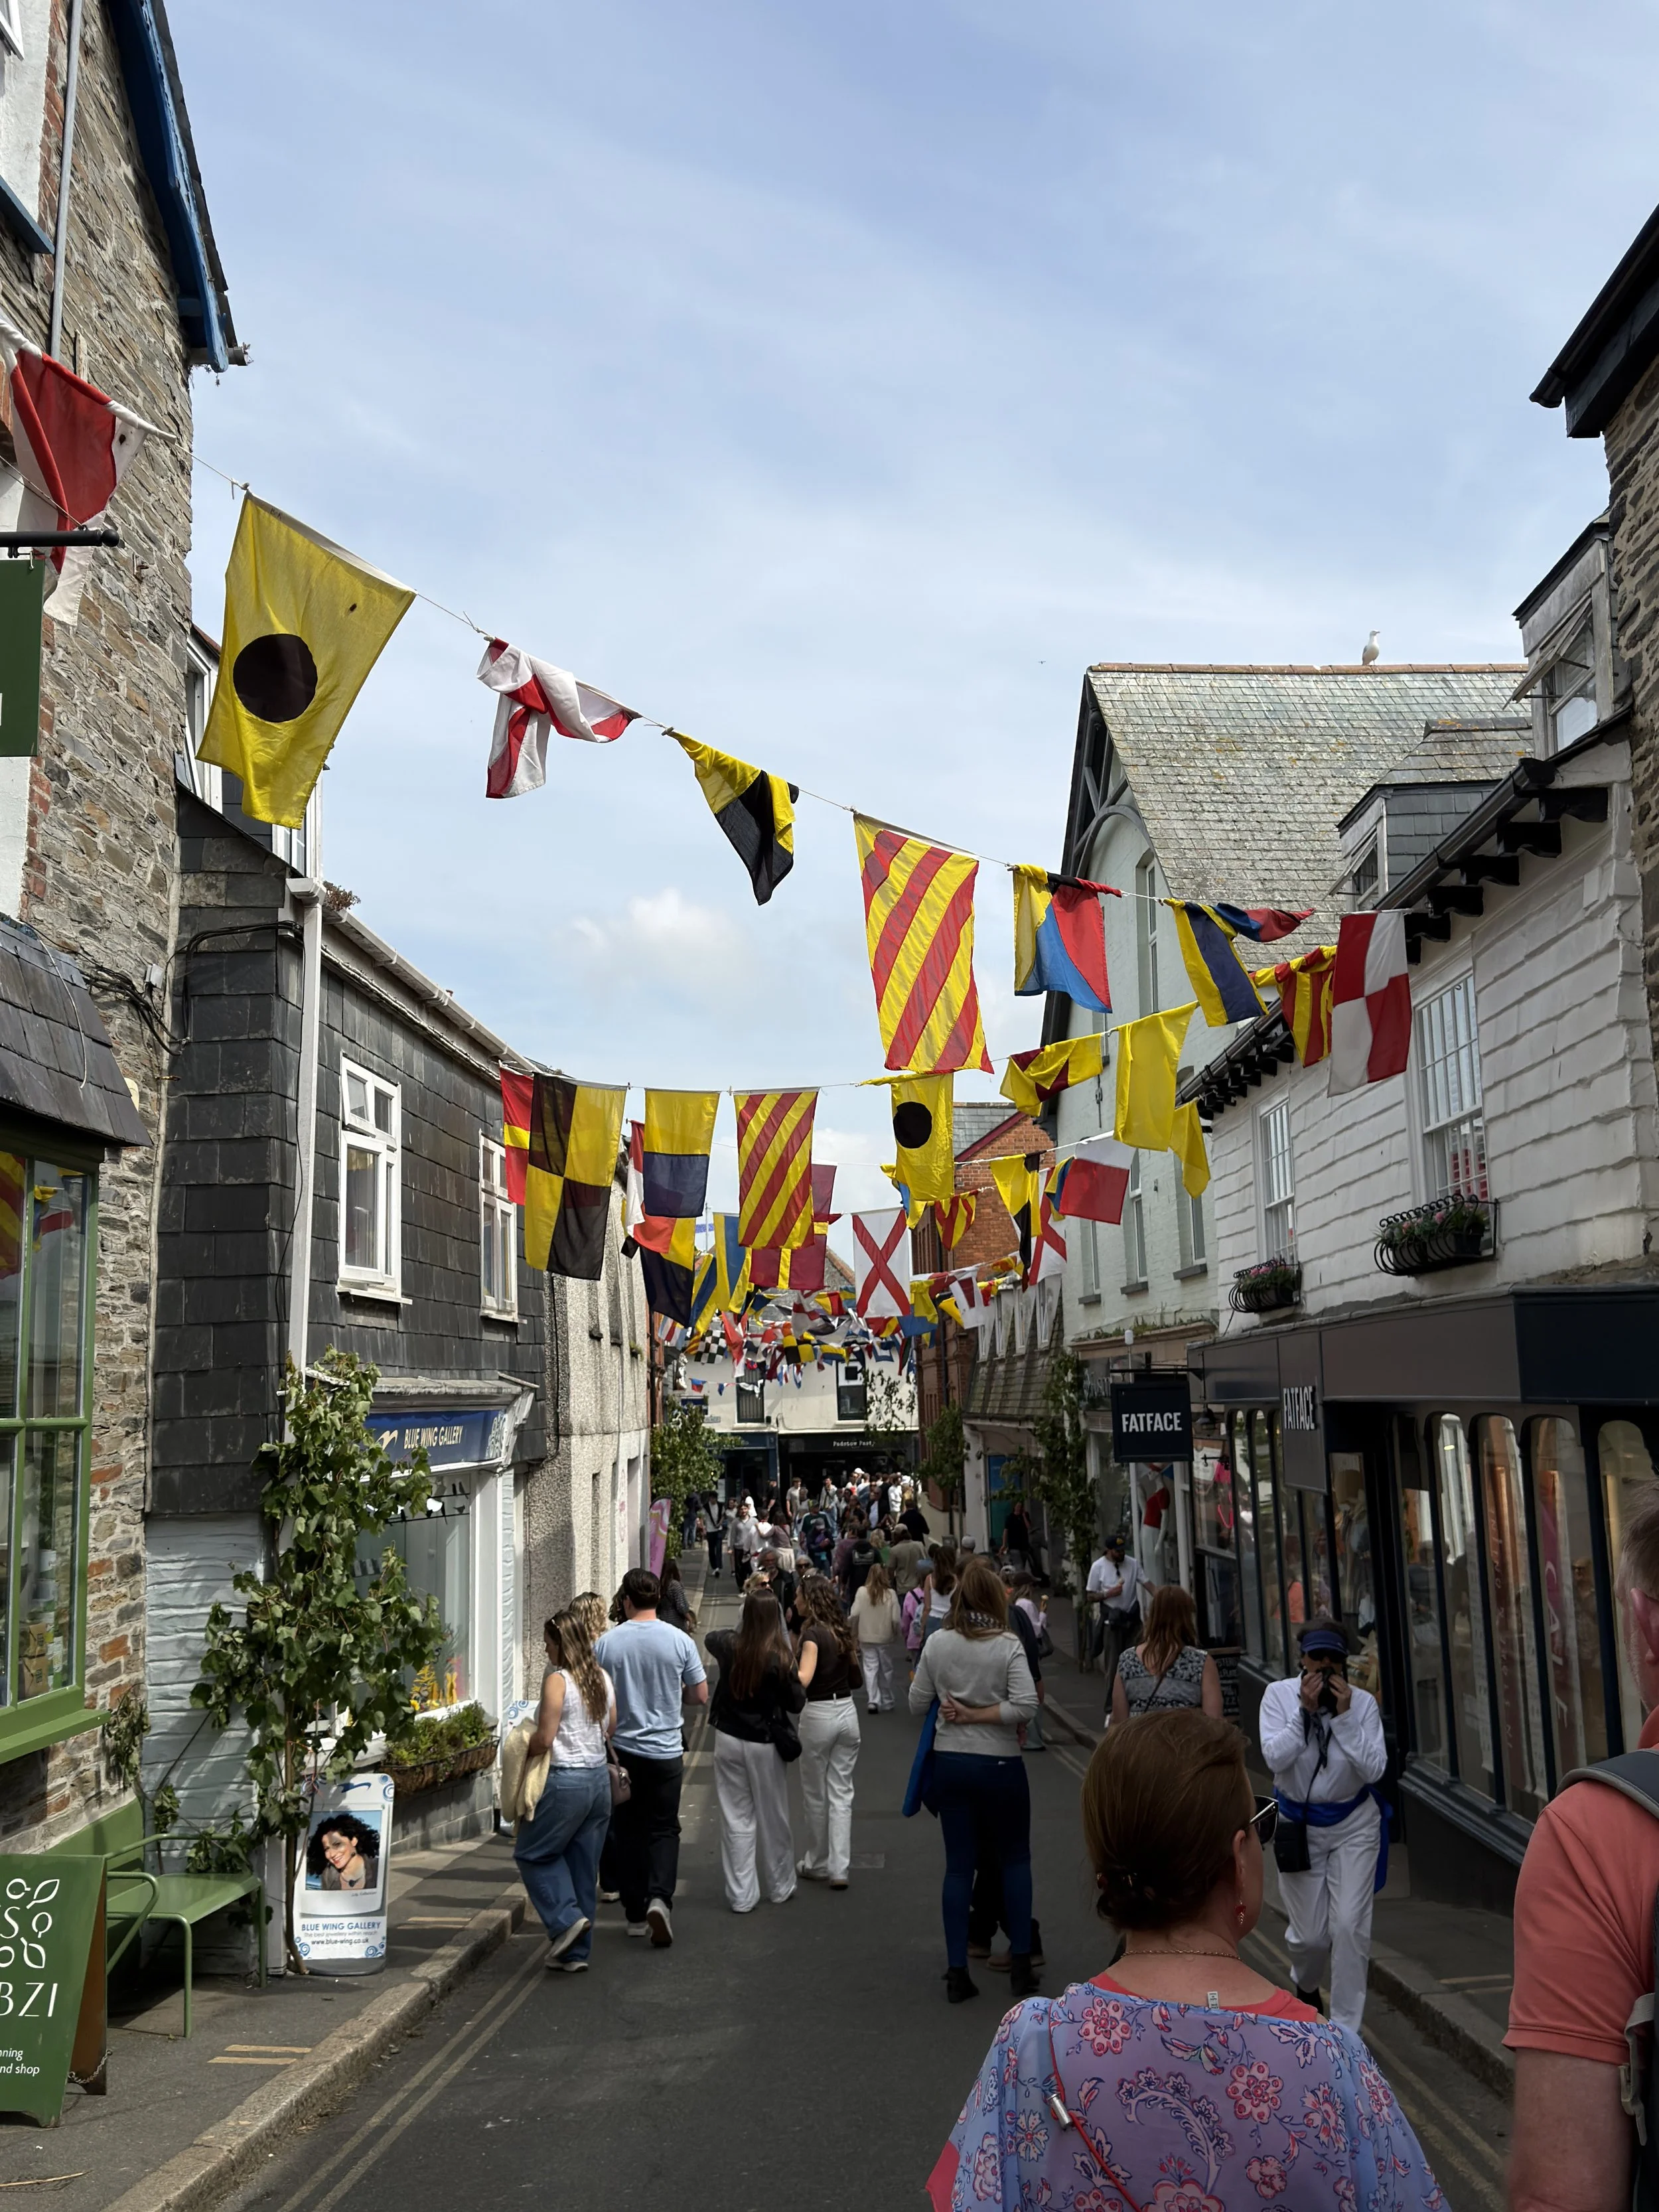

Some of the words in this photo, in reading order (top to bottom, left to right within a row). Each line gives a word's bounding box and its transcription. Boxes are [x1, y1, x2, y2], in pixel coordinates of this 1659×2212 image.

[1283, 1386, 1315, 1430] FATFACE
[1121, 1412, 1182, 1433] FATFACE
[403, 1428, 420, 1449] BLUE
[420, 1427, 438, 1447] WING
[439, 1425, 463, 1446] GALLERY
[15, 2063, 40, 2077] shop
